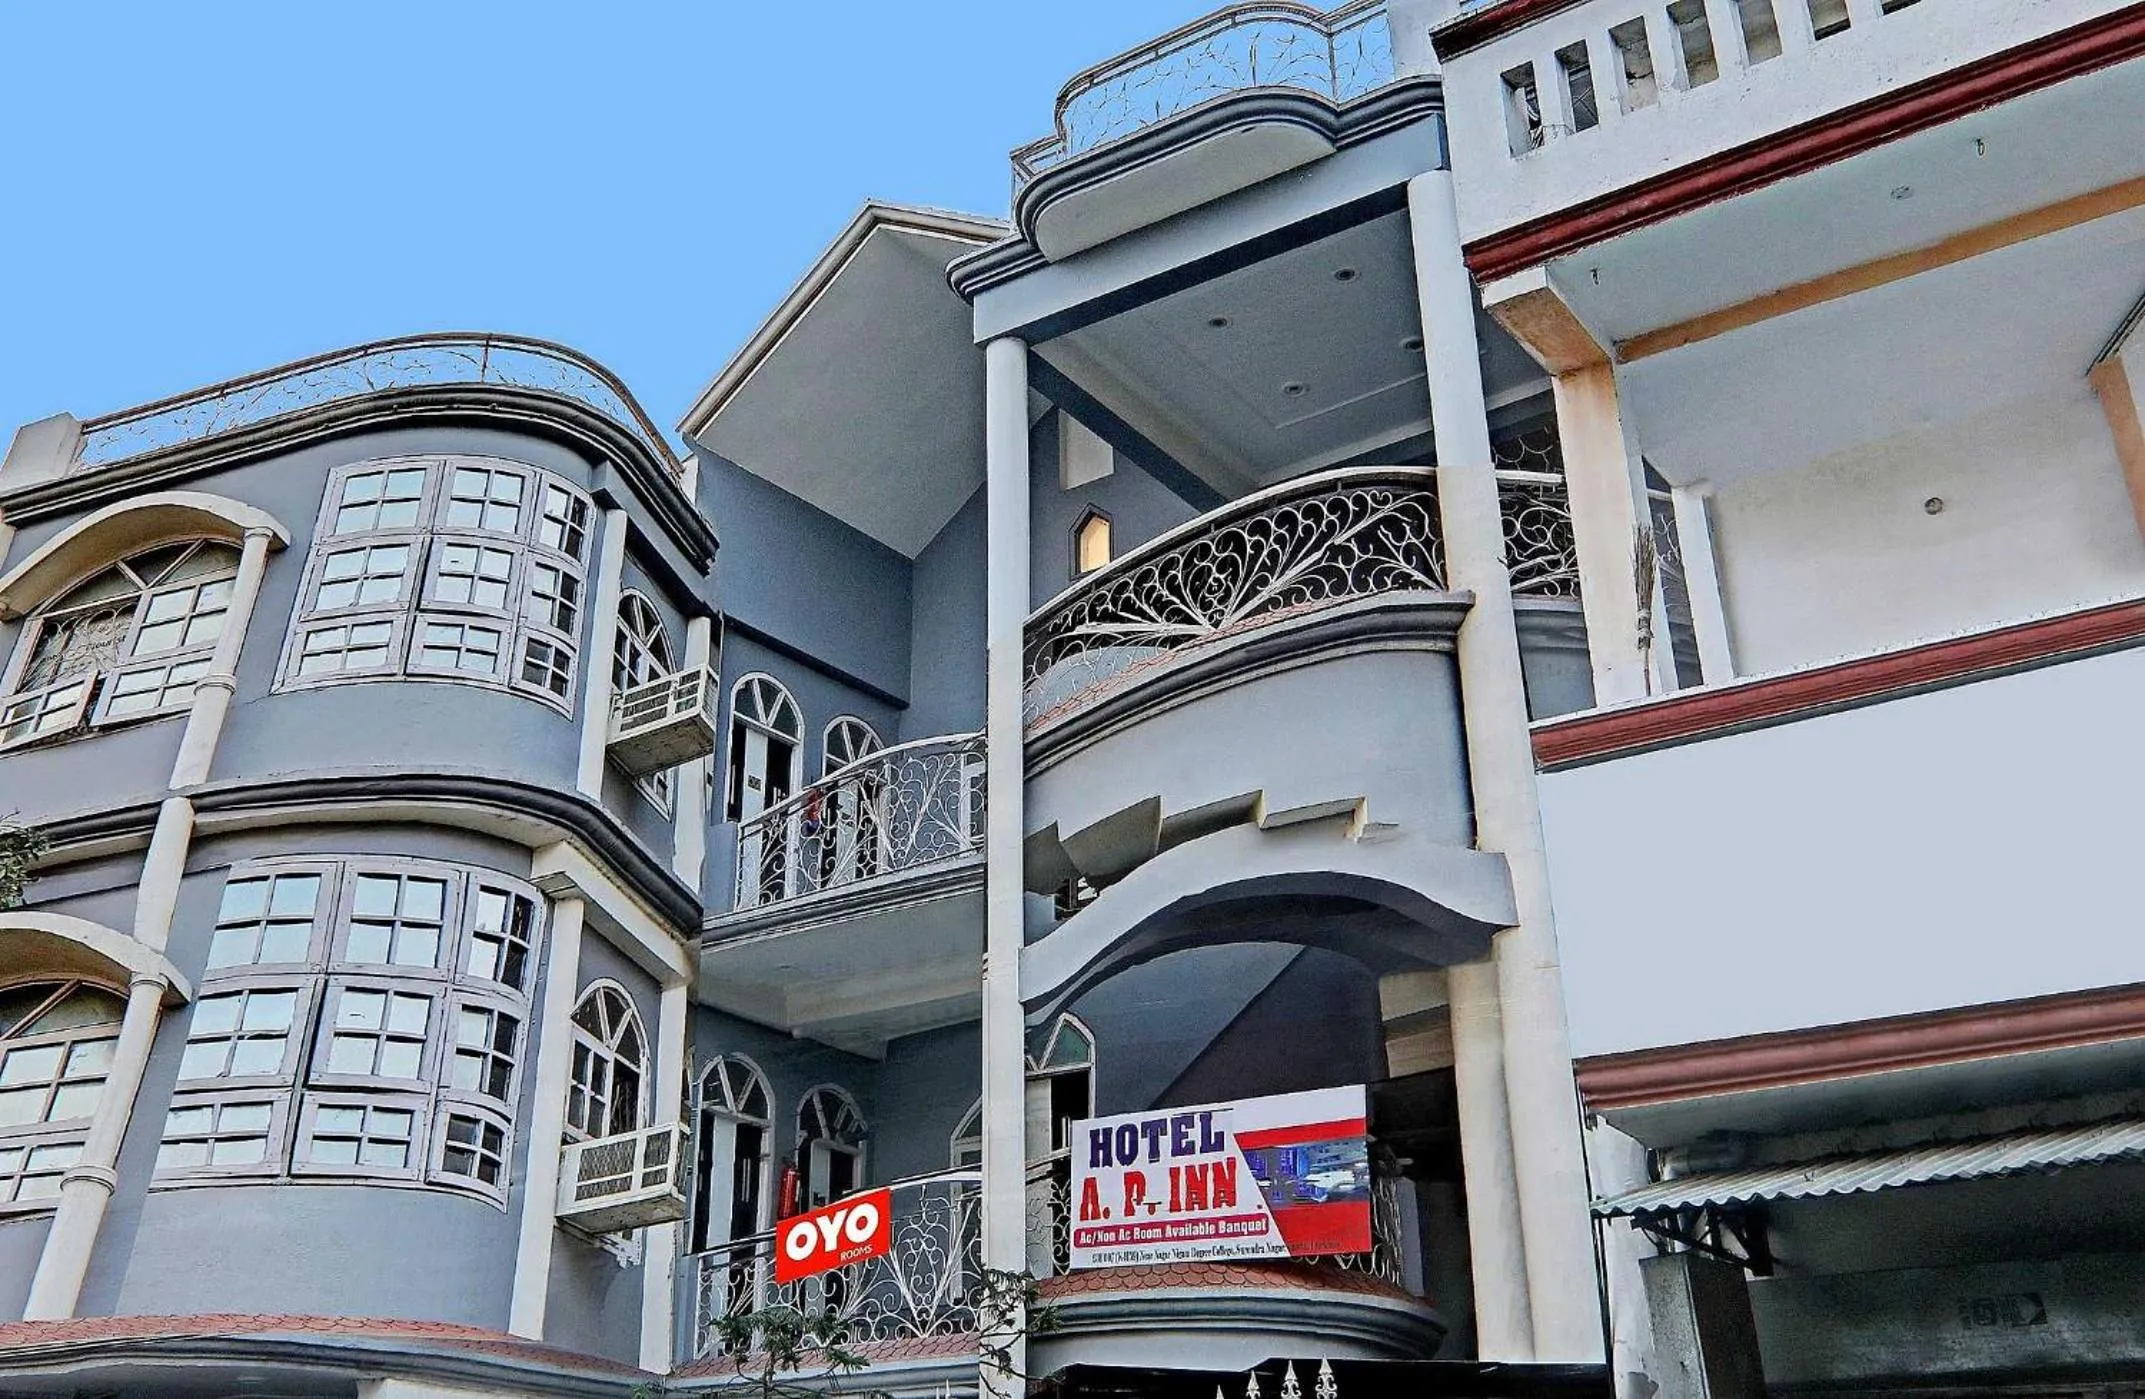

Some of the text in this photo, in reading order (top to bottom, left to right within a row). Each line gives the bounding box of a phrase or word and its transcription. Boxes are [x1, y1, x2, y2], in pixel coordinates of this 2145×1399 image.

[1089, 1112, 1225, 1168] HOTEL
[1080, 1177, 1110, 1221] A.
[1169, 1156, 1237, 1213] INN
[786, 1203, 879, 1261] OYO
[840, 1245, 873, 1262] ROOMS
[1119, 1228, 1131, 1241] Ac
[1133, 1226, 1162, 1240] Room
[1165, 1222, 1216, 1238] Available
[1218, 1218, 1267, 1235] Banquet
